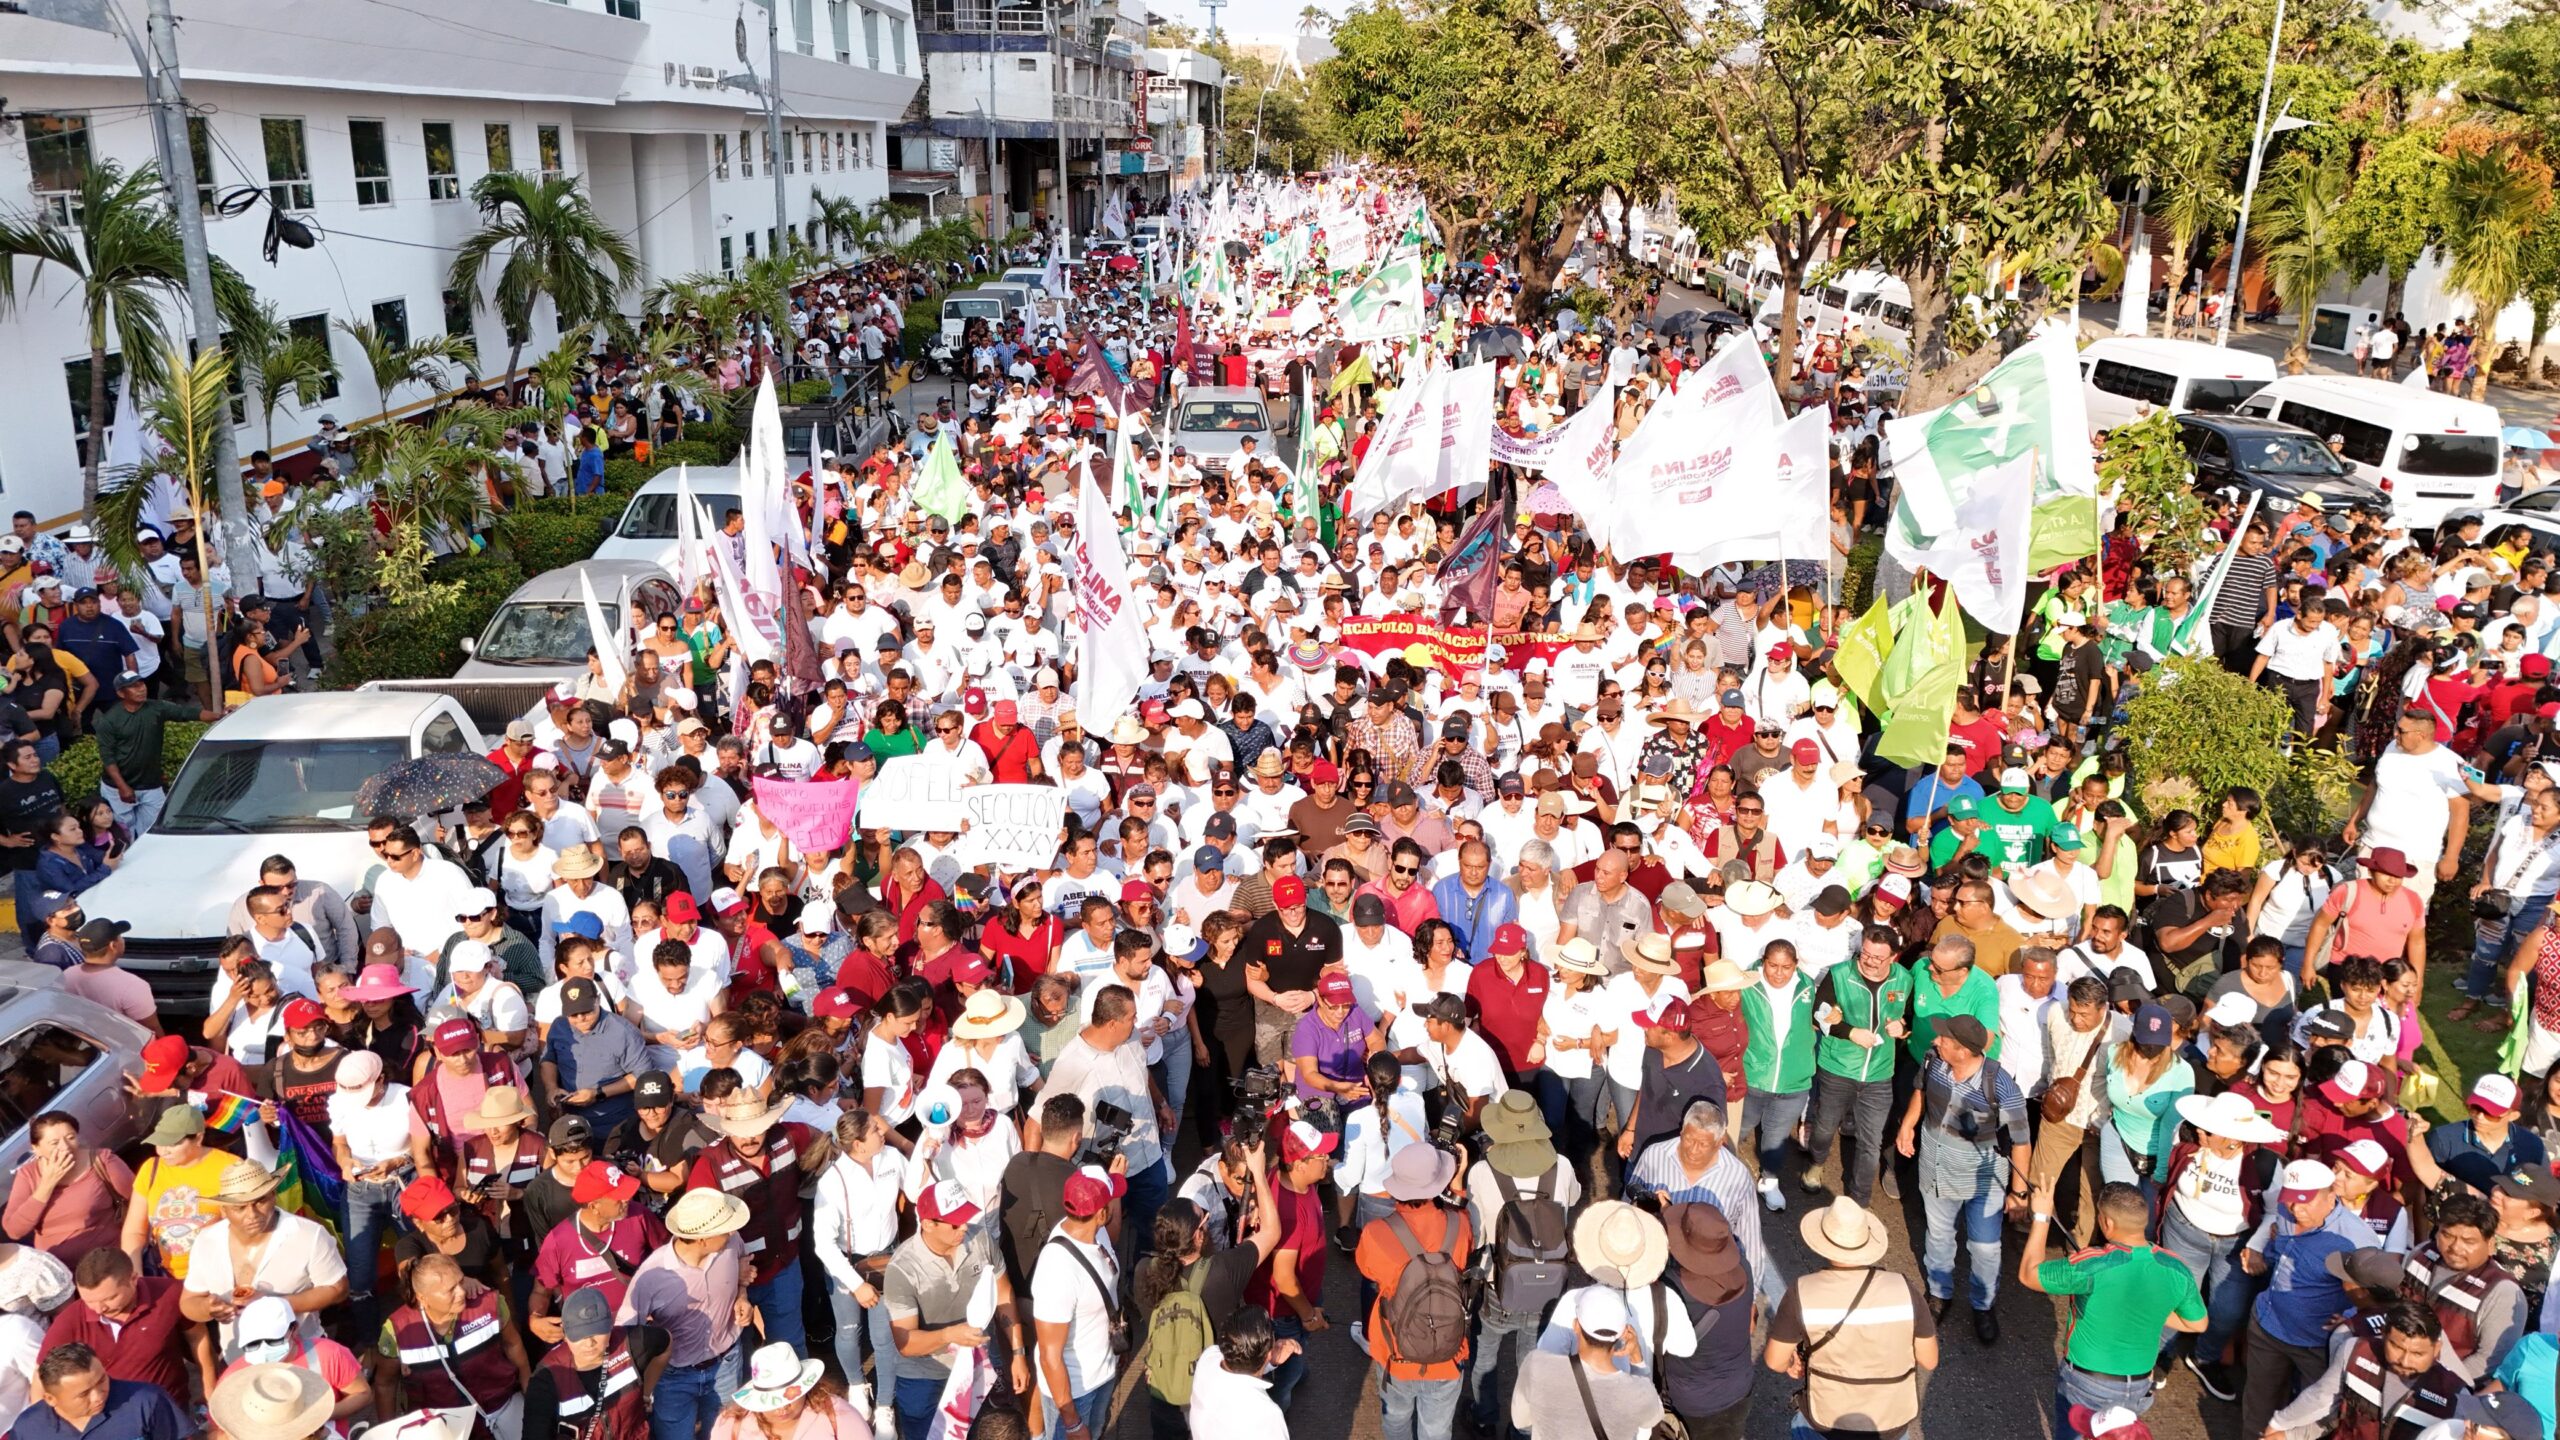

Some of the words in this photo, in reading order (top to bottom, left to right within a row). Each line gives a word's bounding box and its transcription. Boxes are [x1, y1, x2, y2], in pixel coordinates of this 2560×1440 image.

[1342, 621, 1414, 635] ACAPULCO
[1493, 632, 1525, 646] CON
[968, 787, 1064, 829] SECCIÓN
[1062, 889, 1106, 902] ABELINA
[1268, 945, 1281, 954] PT
[443, 1028, 470, 1040] morena
[286, 1087, 305, 1098] ONE
[303, 1095, 326, 1105] CAN
[2193, 1156, 2234, 1186] YUTH
[461, 1312, 492, 1333] morena
[2421, 1388, 2448, 1404] morena
